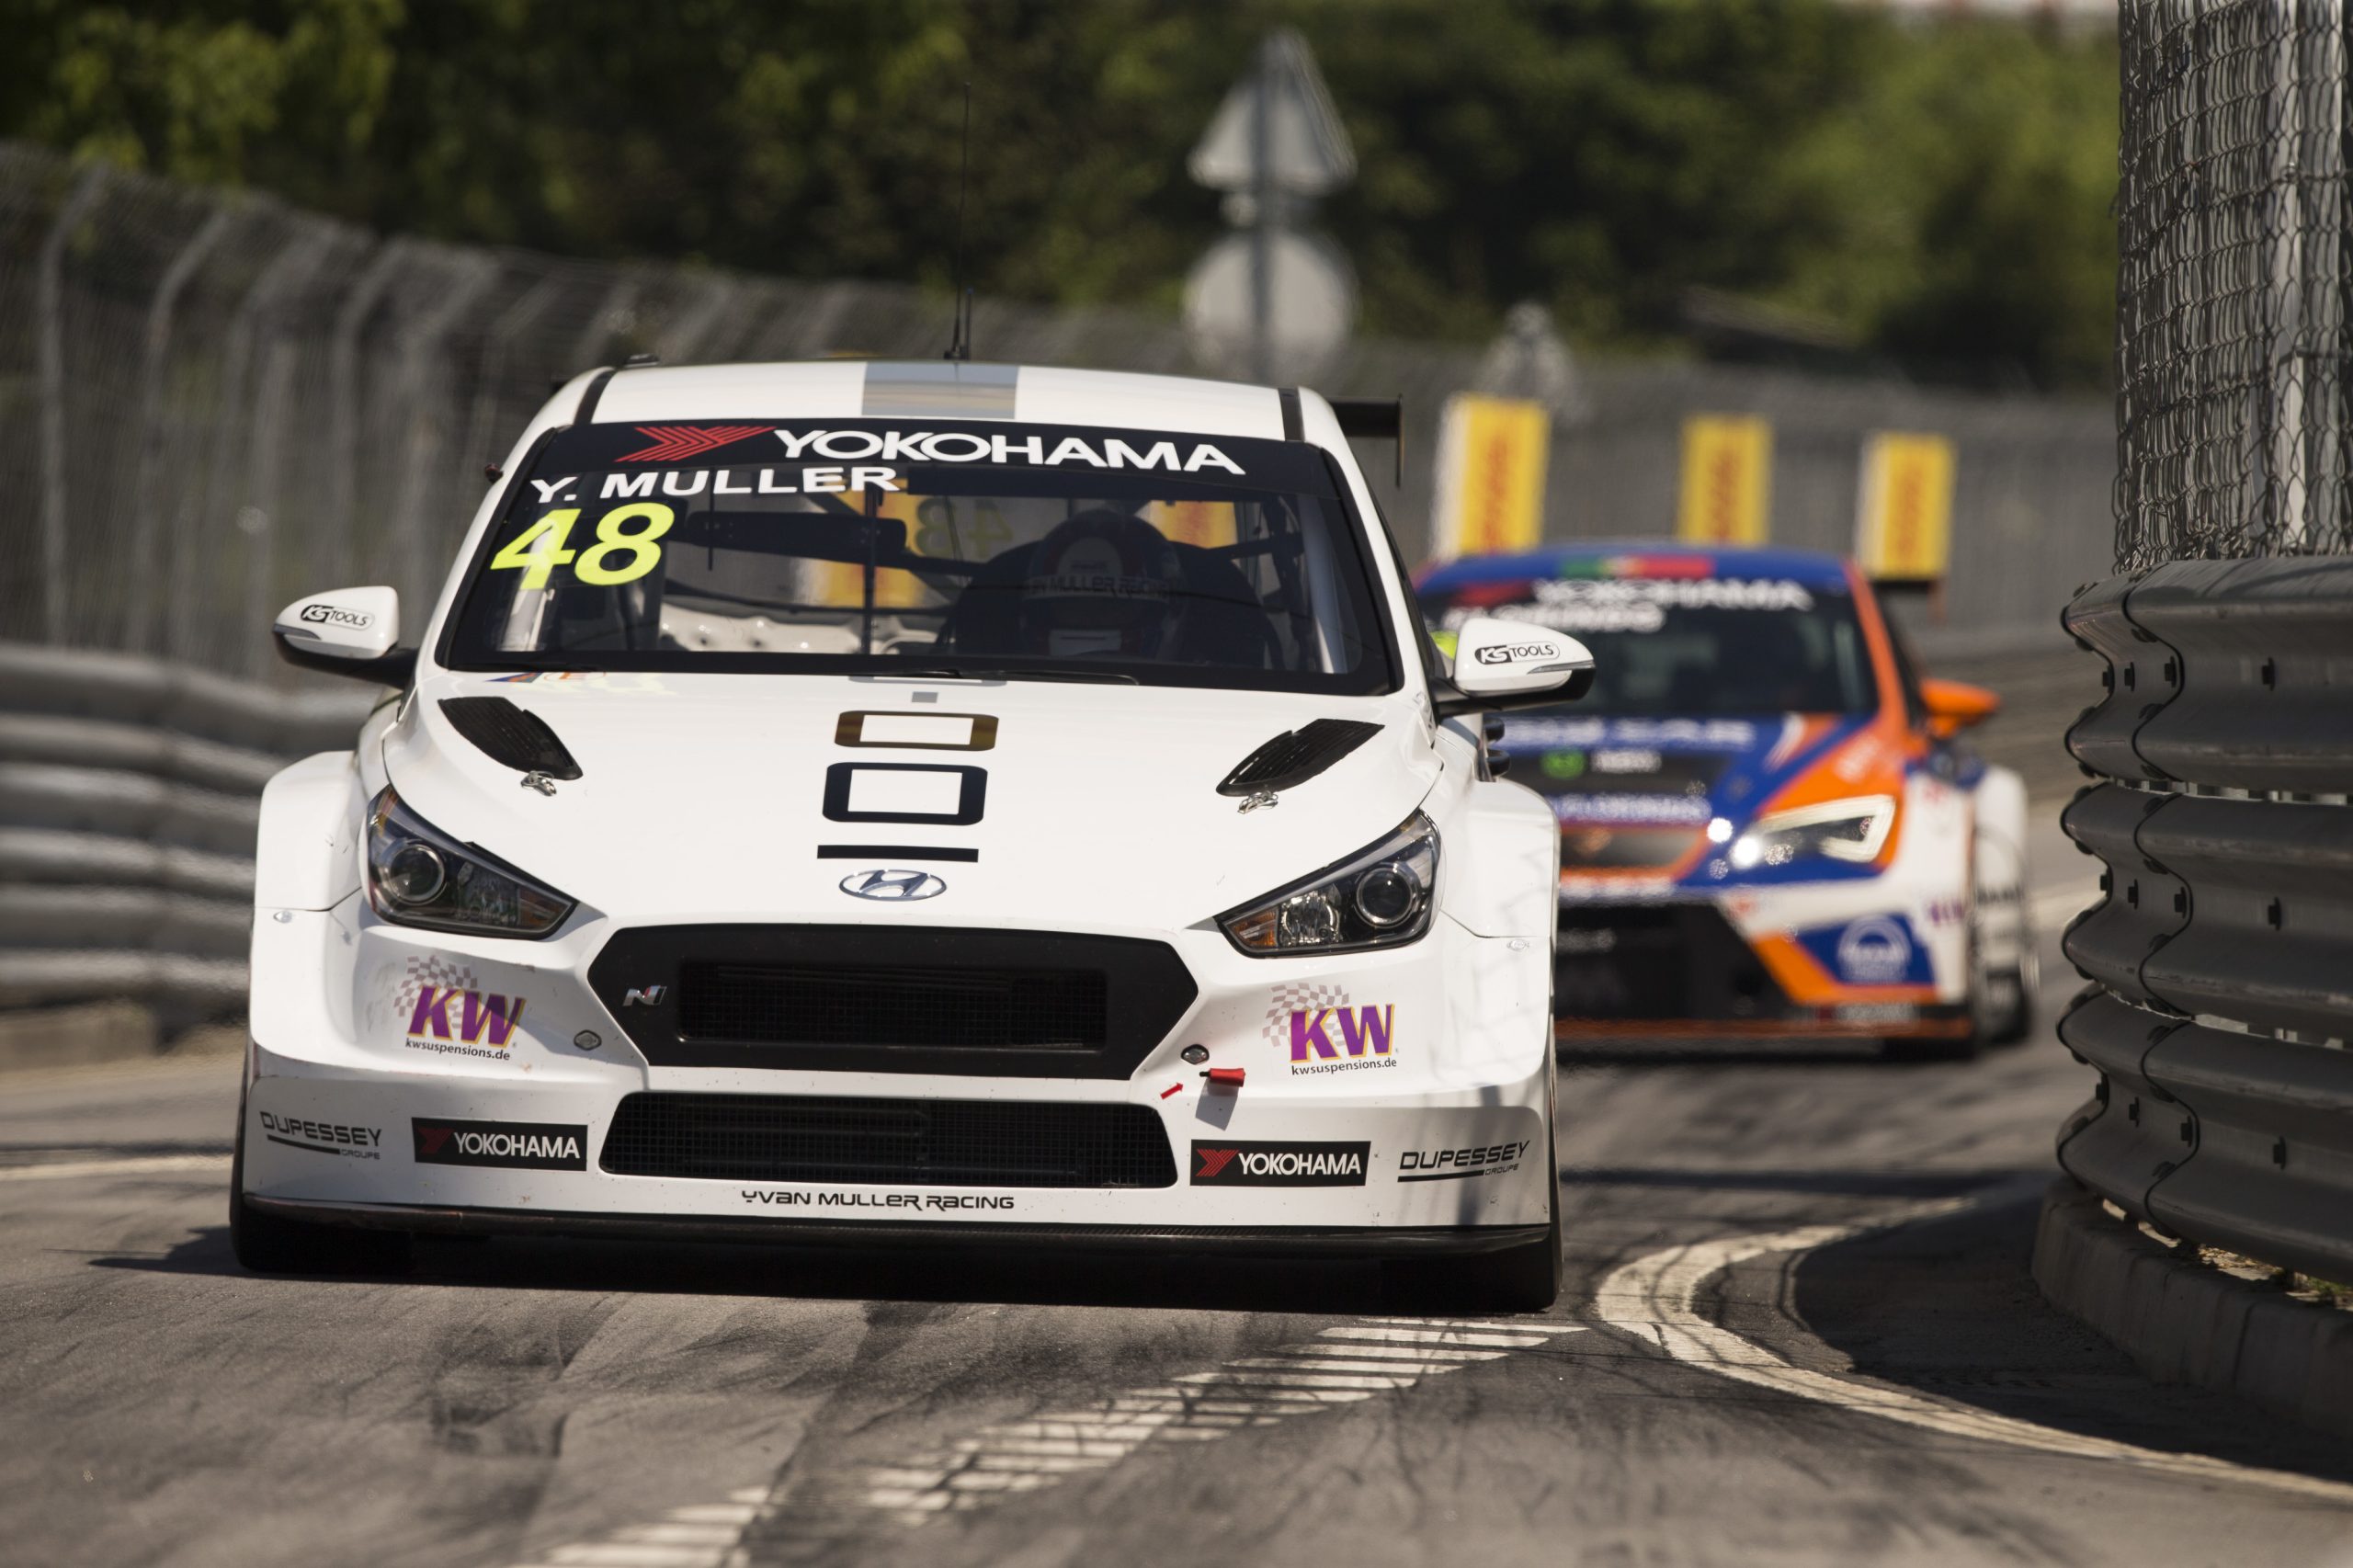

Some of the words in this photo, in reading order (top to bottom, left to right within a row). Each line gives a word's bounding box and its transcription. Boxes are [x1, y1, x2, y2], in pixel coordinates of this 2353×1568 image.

[774, 428, 1246, 475] YOKOHAMA
[529, 475, 578, 504] Y.
[599, 466, 901, 499] MULLER
[490, 502, 676, 590] 48
[331, 610, 368, 626] TOOLS
[1510, 644, 1554, 658] TOOLS
[407, 983, 527, 1049] KW
[1290, 1004, 1395, 1063] KW
[405, 1038, 511, 1061] kwsuspensions.de
[1290, 1057, 1397, 1076] kwsuspensions.de
[259, 1110, 382, 1147] DUPESSEY
[453, 1131, 581, 1160] YOKOHAMA
[1398, 1140, 1531, 1171] DUPESSEY
[1237, 1152, 1362, 1176] YOKOHAMA
